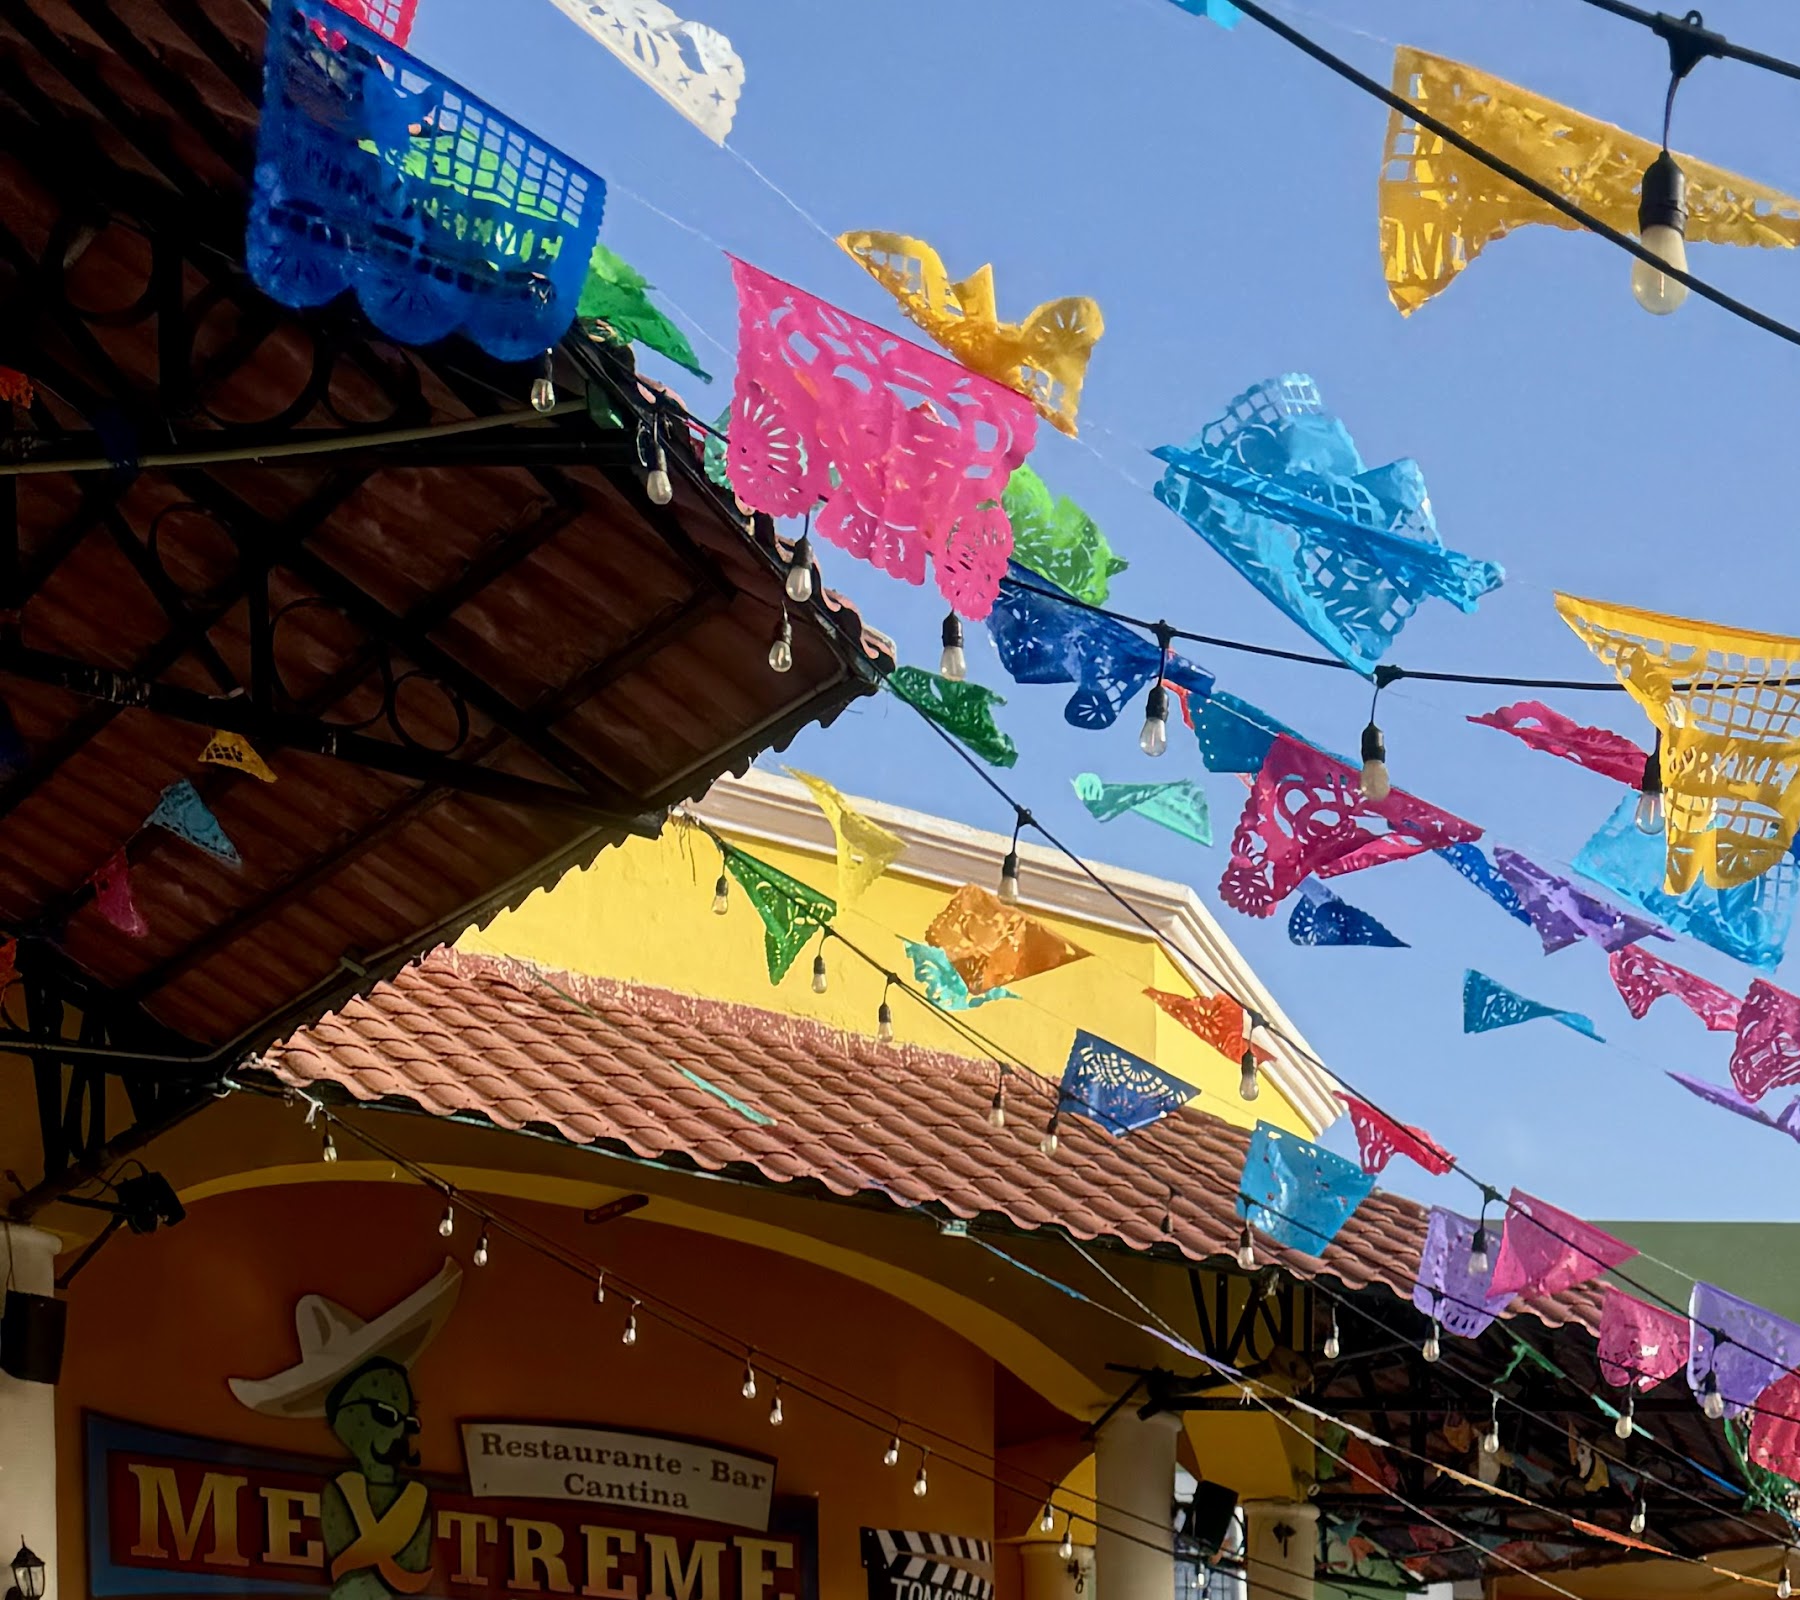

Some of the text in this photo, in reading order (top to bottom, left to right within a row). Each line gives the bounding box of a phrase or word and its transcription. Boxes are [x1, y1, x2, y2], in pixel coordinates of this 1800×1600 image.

[480, 1431, 683, 1476] Restaurante
[709, 1459, 768, 1491] Bar
[563, 1472, 690, 1510] Cantina
